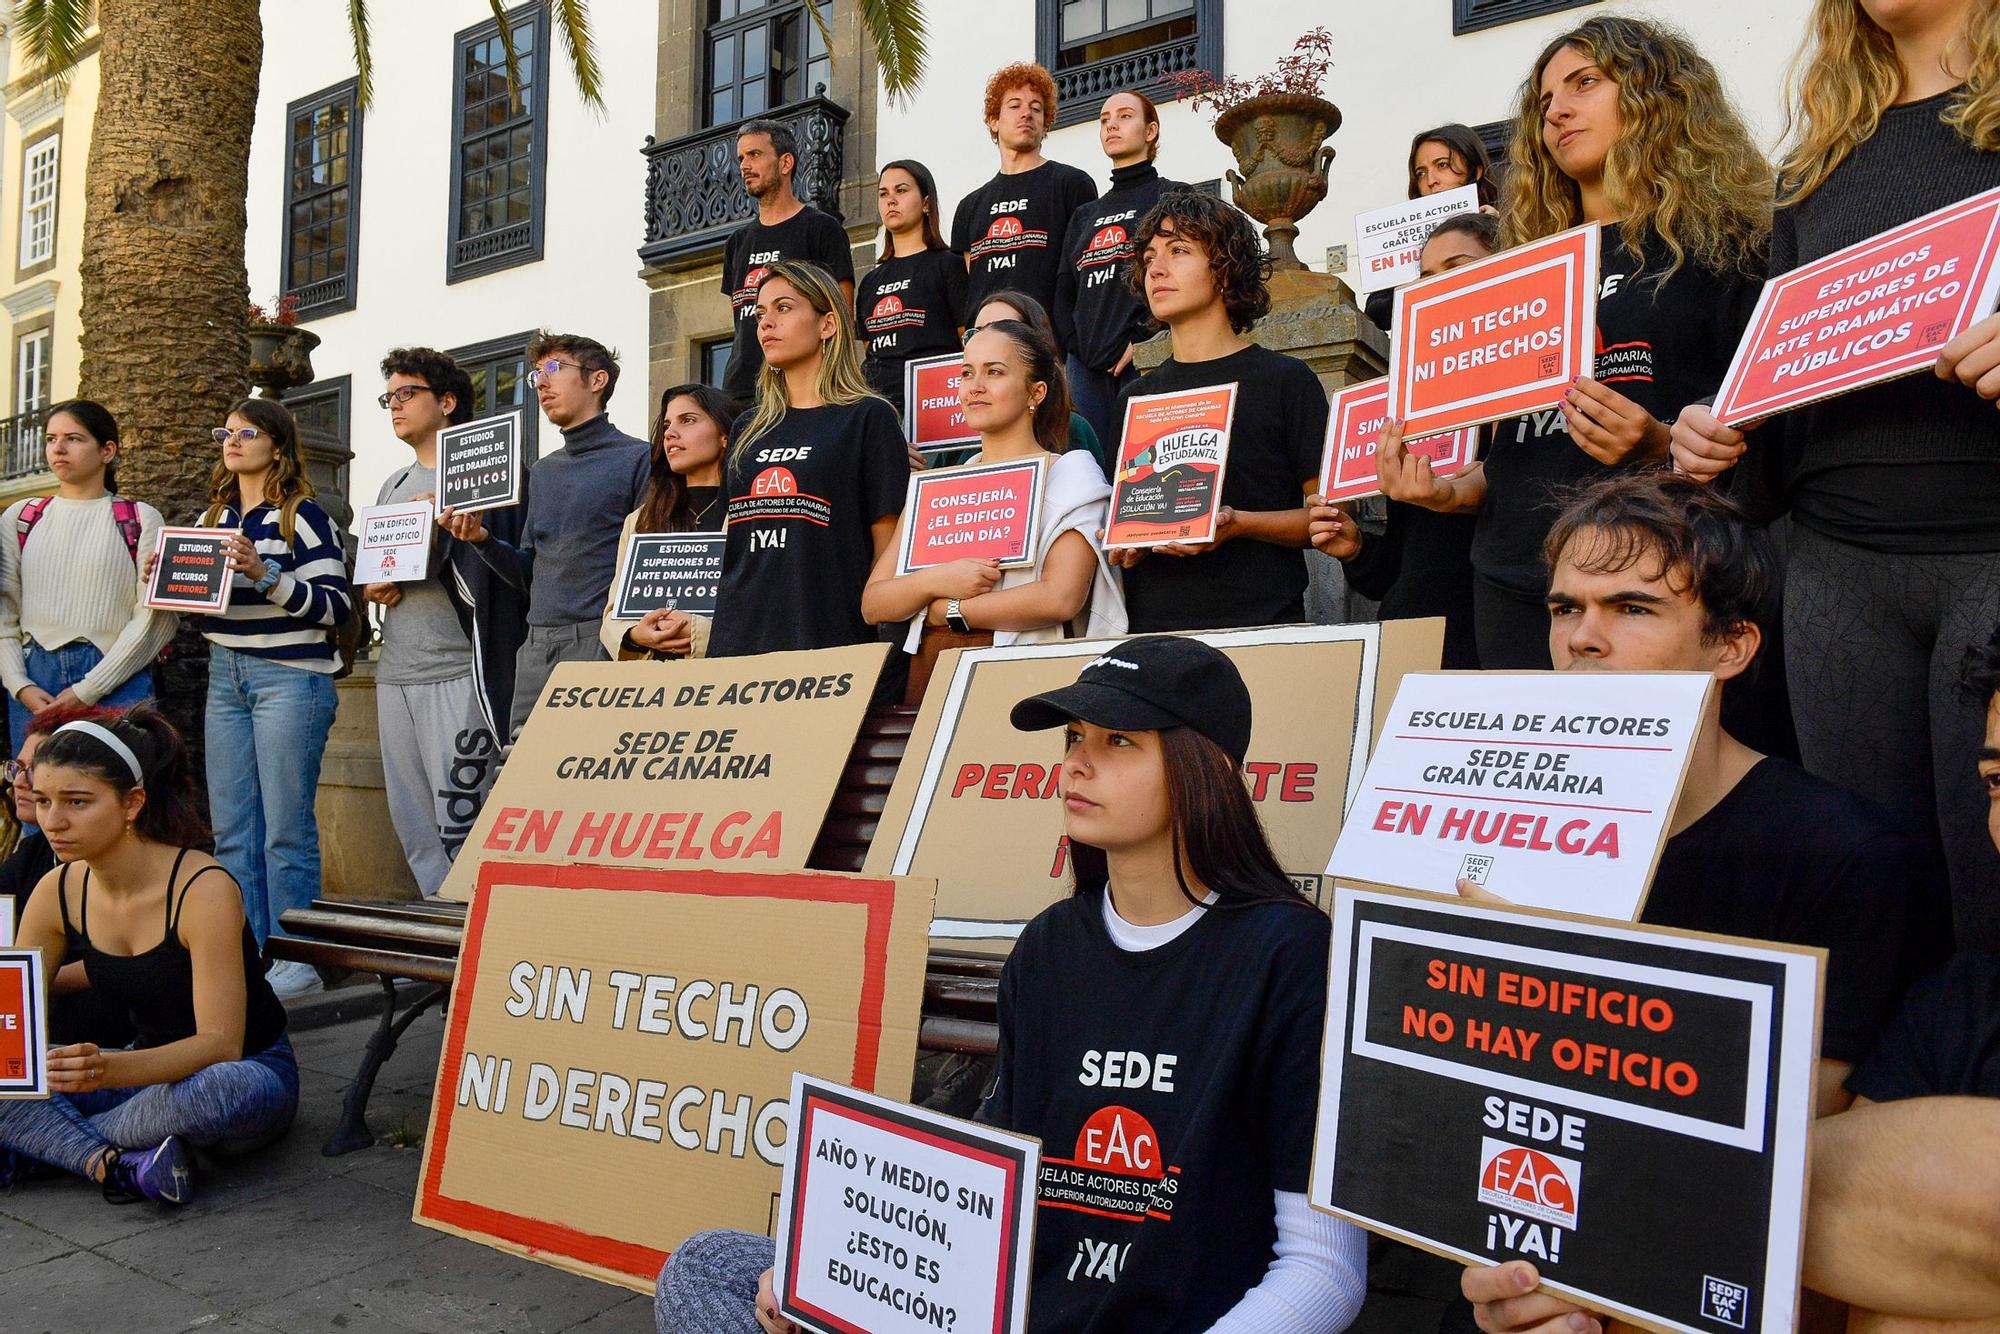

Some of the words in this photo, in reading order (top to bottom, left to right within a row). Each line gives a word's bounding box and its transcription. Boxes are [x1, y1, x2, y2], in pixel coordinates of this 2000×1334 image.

[990, 199, 1028, 214] SEDE
[1094, 210, 1136, 227] SEDE
[1365, 217, 1406, 233] ESCUELA
[1410, 211, 1422, 221] DE
[1425, 200, 1468, 218] ACTORES
[992, 220, 1018, 235] EAC
[1398, 225, 1422, 238] SEDE
[1095, 229, 1122, 247] EAC
[1382, 236, 1408, 249] GRAN
[749, 251, 780, 264] SEDE
[988, 254, 1016, 272] ¡YA!
[1371, 256, 1394, 272] EN
[1087, 264, 1115, 288] ¡YA!
[1816, 245, 1932, 300] ESTUDIOS
[876, 280, 910, 295] SEDE
[1777, 272, 1916, 335] SUPERIORES
[1922, 257, 1959, 283] DE
[877, 299, 899, 315] EAC
[1429, 321, 1464, 347] SIN
[1471, 298, 1547, 335] TECHO
[1757, 331, 1813, 363] ARTE
[1816, 281, 1961, 343] DRAMÁTICO
[873, 333, 896, 352] ¡YA!
[1415, 360, 1435, 382] NI
[1442, 326, 1562, 375] DERECHOS
[1541, 356, 1557, 364] SEDE
[1772, 322, 1914, 383] PÚBLICOS
[1196, 404, 1221, 412] CANARIAS
[1358, 417, 1384, 436] SIN
[460, 431, 494, 445] ESTUDIOS
[1163, 432, 1217, 453] HUELGA
[450, 445, 492, 461] SUPERIORES
[495, 442, 504, 451] DE
[756, 447, 812, 462] SEDE
[1159, 449, 1218, 465] ESTUDIANTIL
[1344, 445, 1361, 461] NI
[447, 464, 464, 475] ARTE
[466, 455, 507, 471] DRAMÁTICO
[447, 470, 506, 492] PÚBLICOS
[756, 470, 791, 494] EAC
[1132, 486, 1161, 495] Consejería
[756, 499, 784, 507] ACTORES
[797, 499, 830, 514] CANARIAS
[930, 486, 1017, 509] CONSEJERÍA,
[1136, 493, 1164, 502] Educación
[1120, 502, 1155, 514] ¡SOLUCIÓN
[387, 518, 417, 528] EDIFICIO
[928, 515, 950, 530] ¿EL
[955, 507, 1015, 525] EDIFICIO
[380, 534, 393, 542] HAY
[396, 531, 419, 540] OFICIO
[750, 528, 786, 552] ¡YA!
[928, 528, 974, 546] ALGÚN
[978, 526, 1010, 541] DÍA?
[179, 544, 213, 553] ESTUDIOS
[659, 545, 708, 553] ESTUDIOS
[172, 555, 215, 565] SUPERIORES
[643, 558, 703, 567] SUPERIORES
[172, 572, 208, 581] RECURSOS
[382, 570, 392, 578] ¡YA!
[635, 572, 660, 580] ARTE
[663, 569, 721, 580] DRAMÁTICO
[168, 584, 208, 594] INFERIORES
[632, 584, 718, 597] PÚBLICOS
[546, 686, 665, 709] ESCUELA
[674, 684, 711, 707] DE
[719, 673, 853, 705] ACTORES
[1408, 711, 1503, 730] ESCUELA
[1512, 714, 1546, 732] DE
[1551, 716, 1671, 737] ACTORES
[614, 730, 691, 755] SEDE
[695, 729, 737, 753] DE
[556, 756, 634, 780] GRAN
[643, 753, 772, 780] CANARIA
[1467, 749, 1529, 770] SEDE
[1535, 753, 1570, 772] DE
[1422, 765, 1486, 786] GRAN
[1493, 770, 1603, 795] CANARIA
[483, 807, 563, 851] EN
[567, 810, 782, 859] HUELGA
[1372, 801, 1432, 835] EN
[1438, 808, 1619, 859] HUELGA
[1467, 858, 1489, 866] SEDE
[1427, 960, 1485, 998] SIN
[1498, 972, 1674, 1032] EDIFICIO
[504, 961, 591, 1023] SIN
[609, 971, 809, 1052] TECHO
[1402, 1005, 1455, 1042] NO
[1466, 1018, 1541, 1061] HAY
[1552, 1038, 1698, 1097] OFICIO
[1079, 1050, 1178, 1093] SEDE
[458, 1052, 512, 1113] NI
[1482, 1096, 1586, 1151] SEDE
[1086, 1114, 1151, 1170] EAC
[816, 1138, 857, 1169] AÑO
[864, 1154, 876, 1176] Y
[881, 1160, 949, 1203] MEDIO
[957, 1187, 993, 1219] SIN
[1071, 1172, 1085, 1186] DE
[1087, 1175, 1139, 1195] ACTORES
[1142, 1184, 1158, 1197] DE
[1495, 1152, 1565, 1209] EAC
[1045, 1188, 1084, 1202] SUPERIOR
[1086, 1194, 1133, 1211] AUTORIZADO
[1135, 1203, 1145, 1212] DE
[844, 1186, 951, 1251] SOLUCIÓN,
[1487, 1214, 1561, 1263] ¡YA!
[847, 1231, 908, 1270] ¿ESTO
[915, 1254, 940, 1283] ES
[828, 1258, 956, 1332] EDUCACIÓN?
[1709, 1281, 1742, 1300] SEDE
[1712, 1294, 1736, 1310] EAC
[1716, 1306, 1731, 1320] YA
